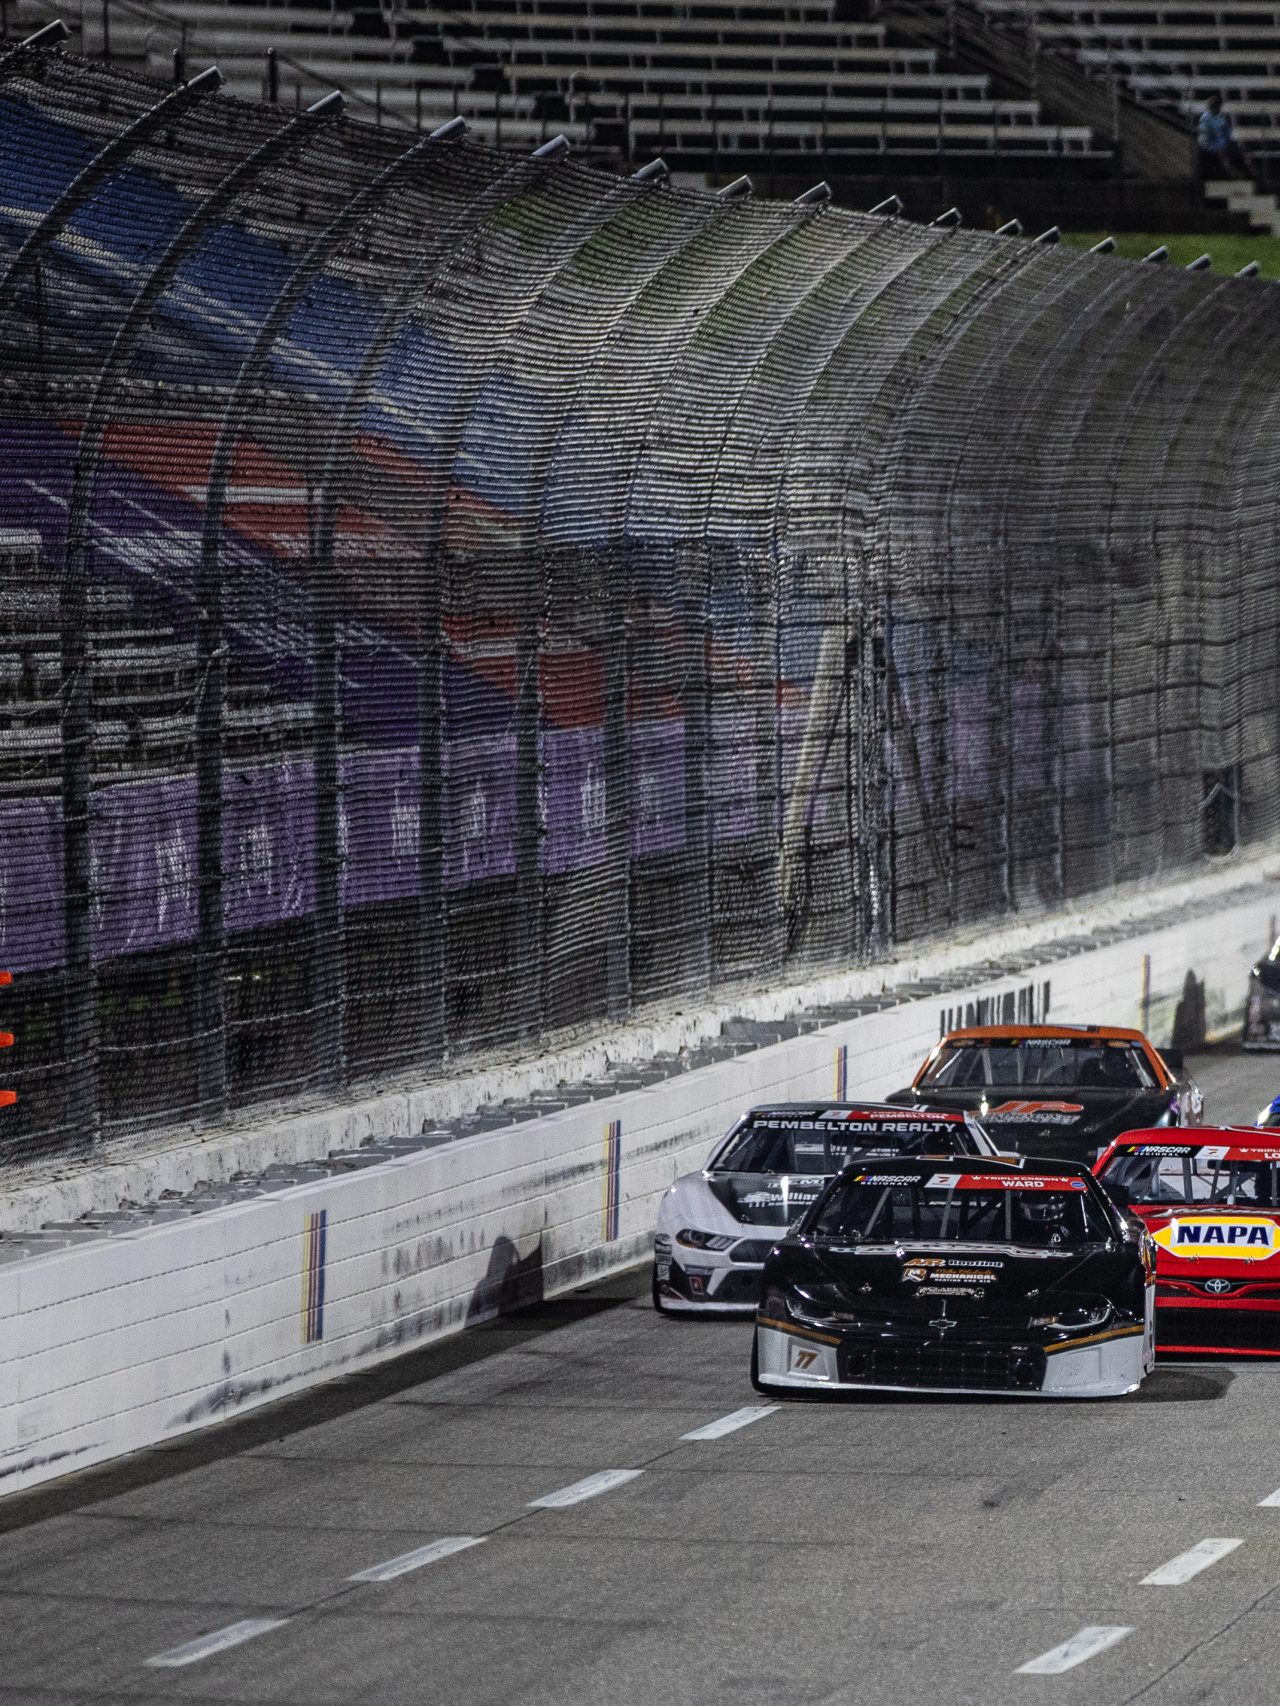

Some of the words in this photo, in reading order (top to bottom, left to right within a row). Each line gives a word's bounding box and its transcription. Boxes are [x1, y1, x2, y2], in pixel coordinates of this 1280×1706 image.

[753, 1120, 877, 1132] PEMBELTON
[881, 1122, 956, 1133] REALTY
[1142, 1145, 1191, 1153] NASCAR
[869, 1175, 921, 1183] NASCAR
[1002, 1180, 1045, 1188] WARD
[1177, 1225, 1269, 1246] NAPA
[794, 1351, 818, 1369] 77
